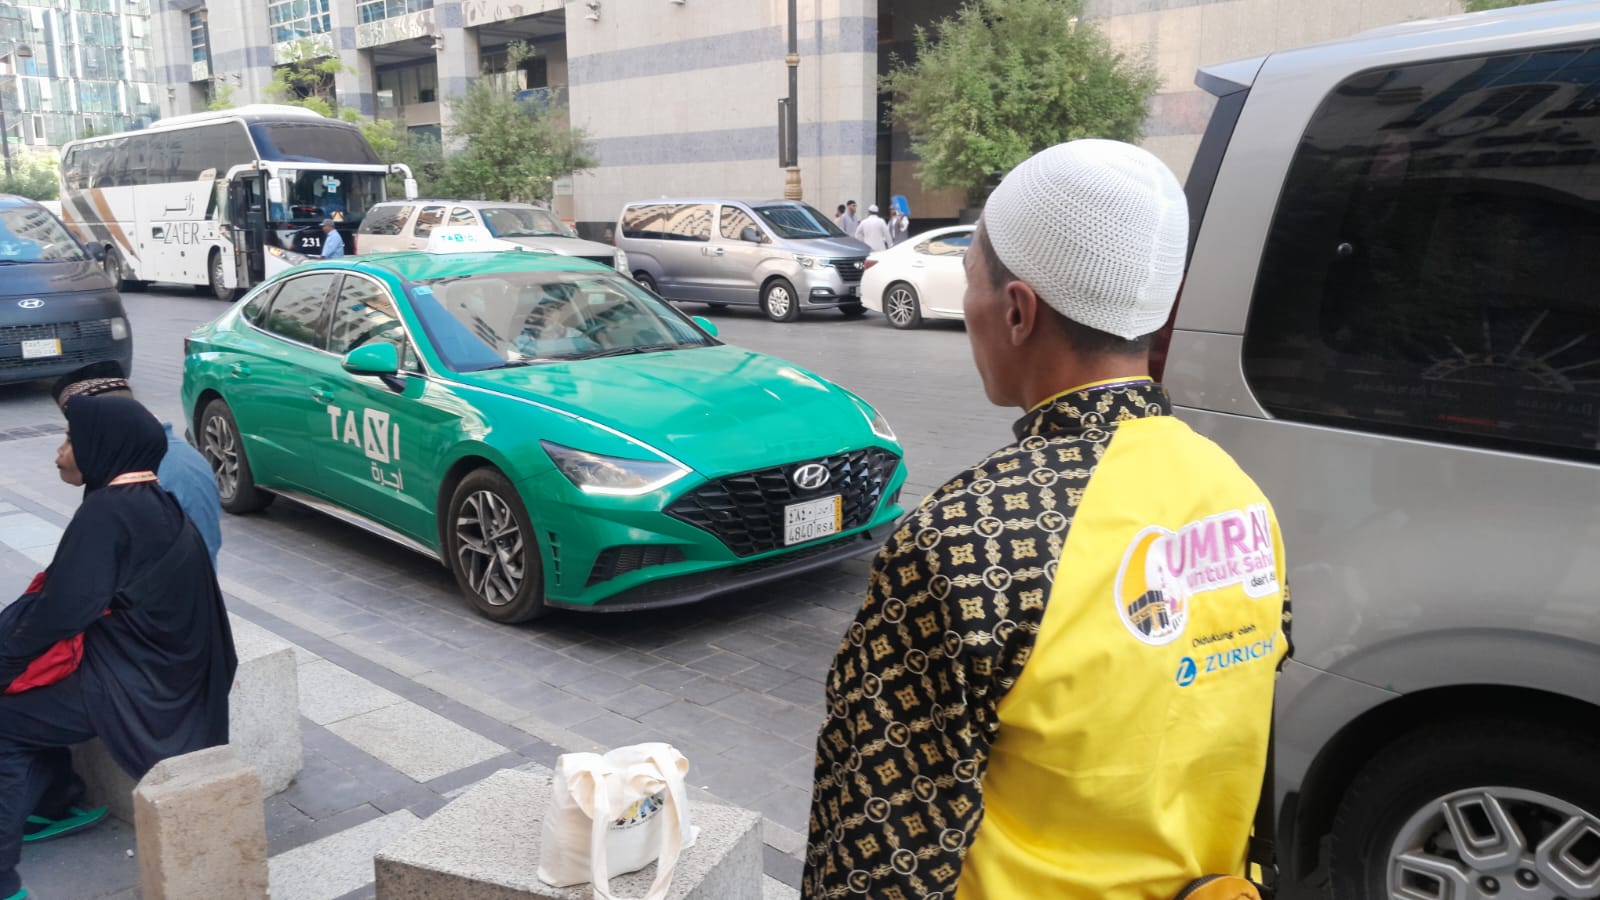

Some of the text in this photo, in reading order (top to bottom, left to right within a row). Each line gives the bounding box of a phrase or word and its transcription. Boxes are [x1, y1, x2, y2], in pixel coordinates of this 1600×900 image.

[301, 237, 321, 247] 231
[327, 405, 400, 464] TAXI
[789, 524, 812, 541] 4840
[1186, 557, 1240, 588] untuk
[1205, 638, 1273, 673] ZURICH
